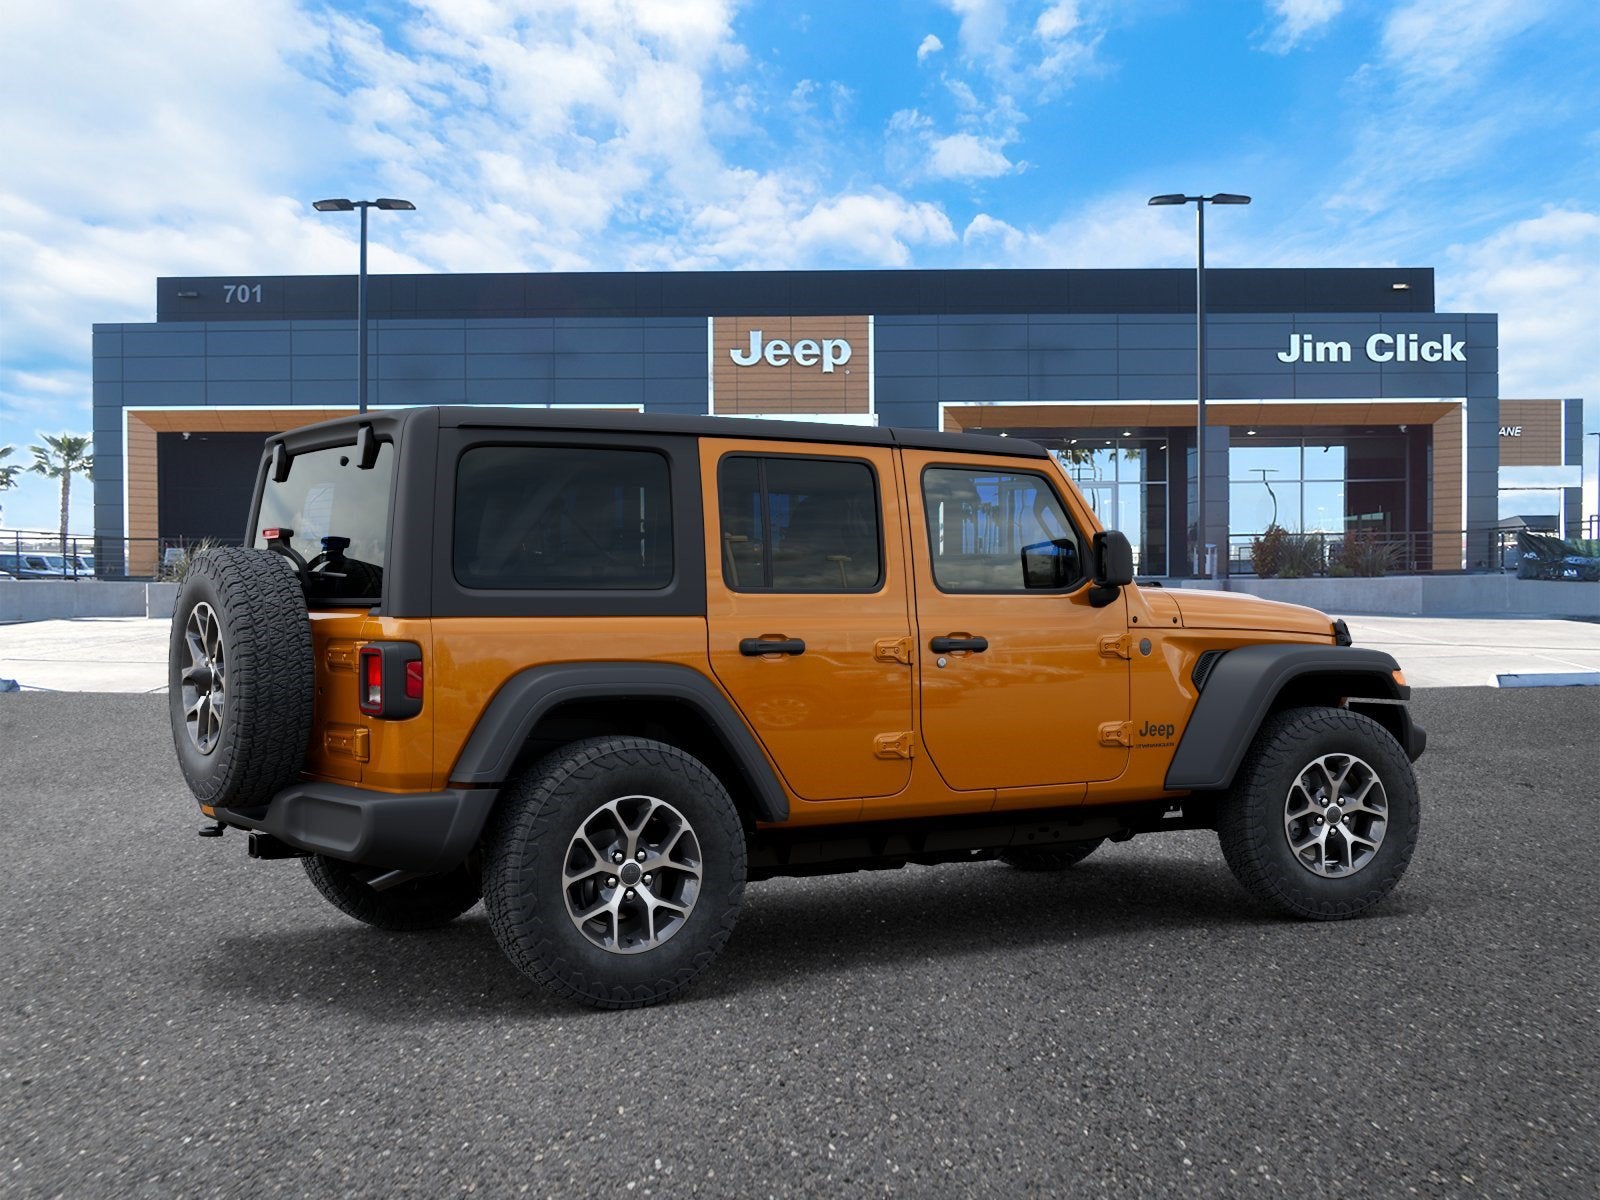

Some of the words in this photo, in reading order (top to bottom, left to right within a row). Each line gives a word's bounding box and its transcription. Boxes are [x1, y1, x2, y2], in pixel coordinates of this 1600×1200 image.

[223, 284, 262, 304] 701
[729, 330, 852, 373] Jeep
[1277, 333, 1352, 363] Jim
[1365, 333, 1467, 363] Click
[1139, 720, 1175, 740] Jeep
